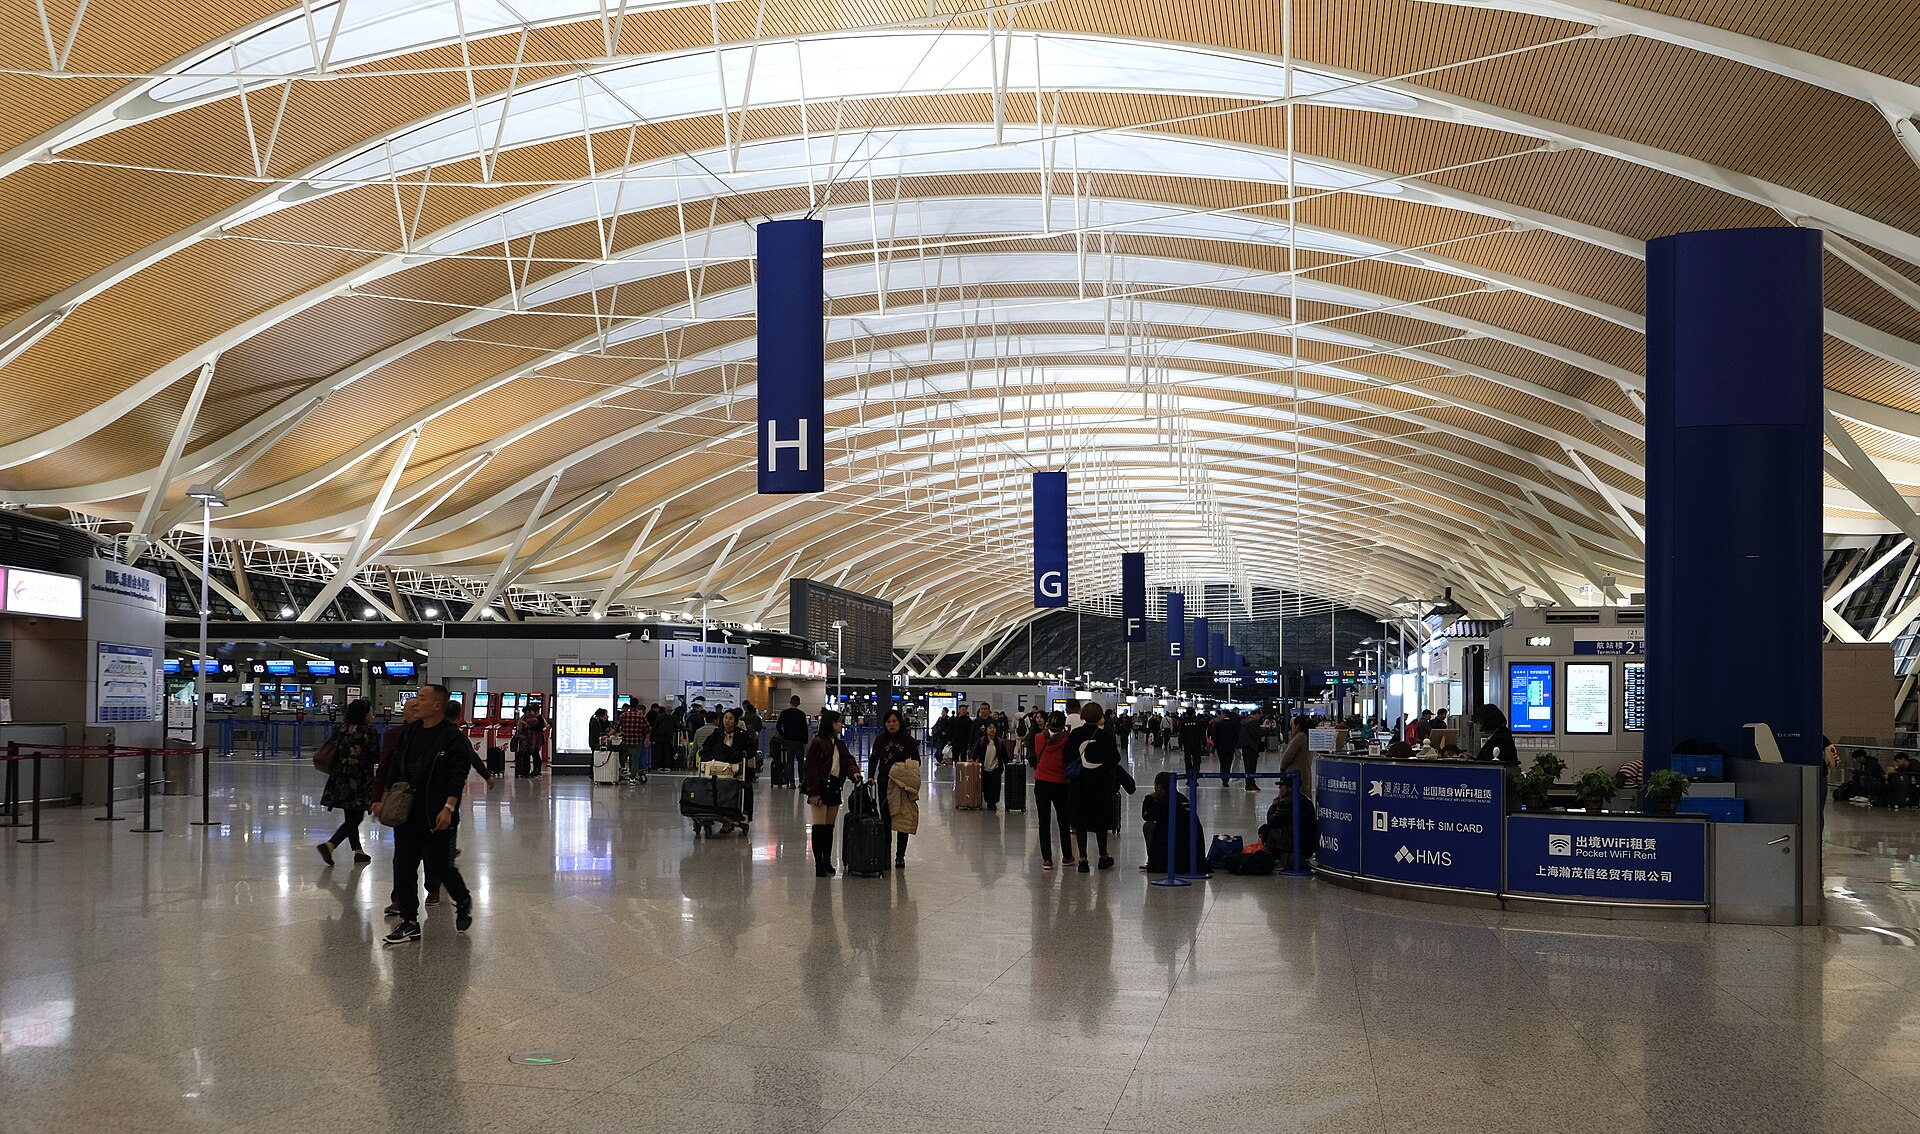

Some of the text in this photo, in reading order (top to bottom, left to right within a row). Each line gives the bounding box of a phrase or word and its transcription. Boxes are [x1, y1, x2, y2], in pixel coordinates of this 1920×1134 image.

[767, 418, 808, 472] H
[1039, 570, 1062, 598] G
[1127, 617, 1140, 636] F
[664, 643, 675, 658] H
[1170, 642, 1181, 656] E
[1625, 641, 1635, 655] 2
[222, 664, 234, 673] 04
[253, 664, 265, 673] 03
[339, 665, 350, 674] 02
[556, 665, 565, 675] H
[1196, 657, 1206, 669] D
[372, 666, 383, 675] 01
[1390, 815, 1483, 834] 全球手机卡 SIM CARD
[1575, 835, 1657, 851] 出境WiFi租赁
[1416, 849, 1452, 867] HMS
[1575, 848, 1657, 860] Pocket WiFi Rent
[1535, 865, 1673, 883] 上海瀚茂信经贸有限公司
